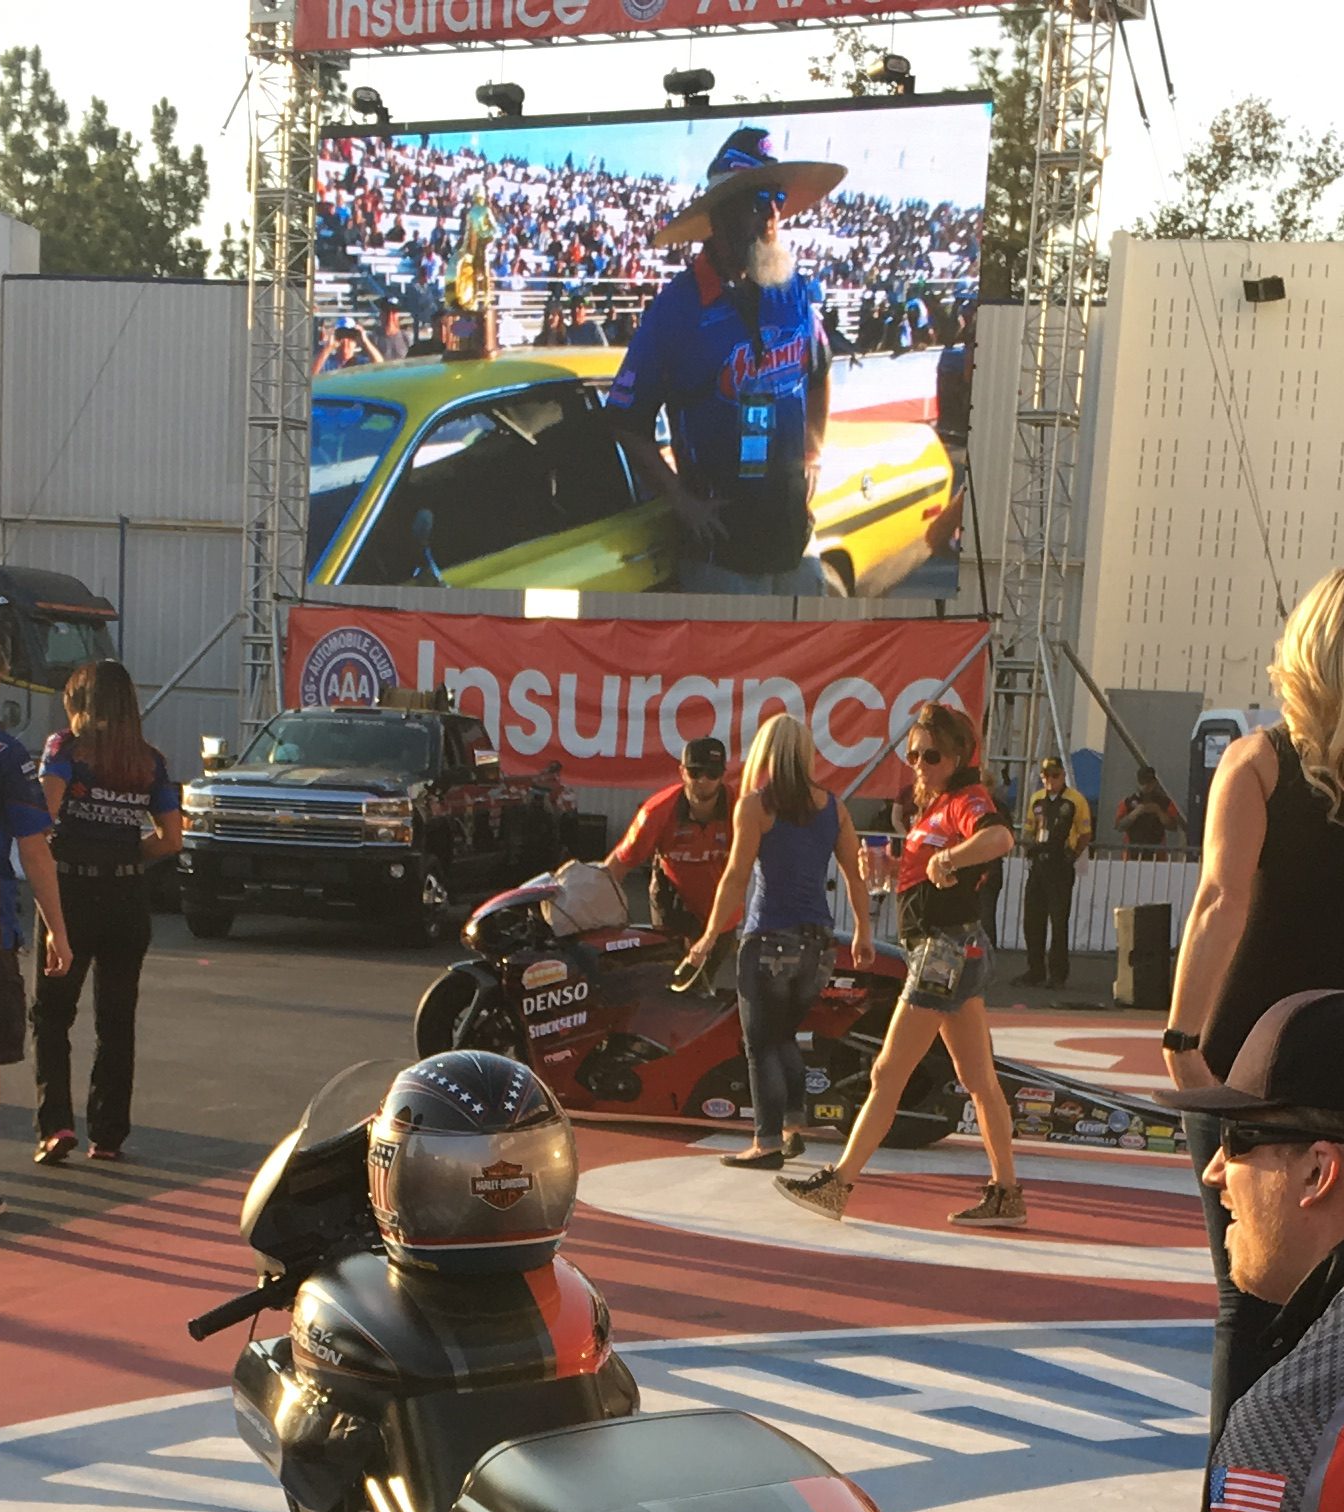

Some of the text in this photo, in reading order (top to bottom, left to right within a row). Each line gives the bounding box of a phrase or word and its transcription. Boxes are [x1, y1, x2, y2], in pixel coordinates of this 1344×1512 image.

[369, 645, 394, 680] CLUB
[327, 671, 370, 703] AAA
[521, 982, 589, 1016] DENSO
